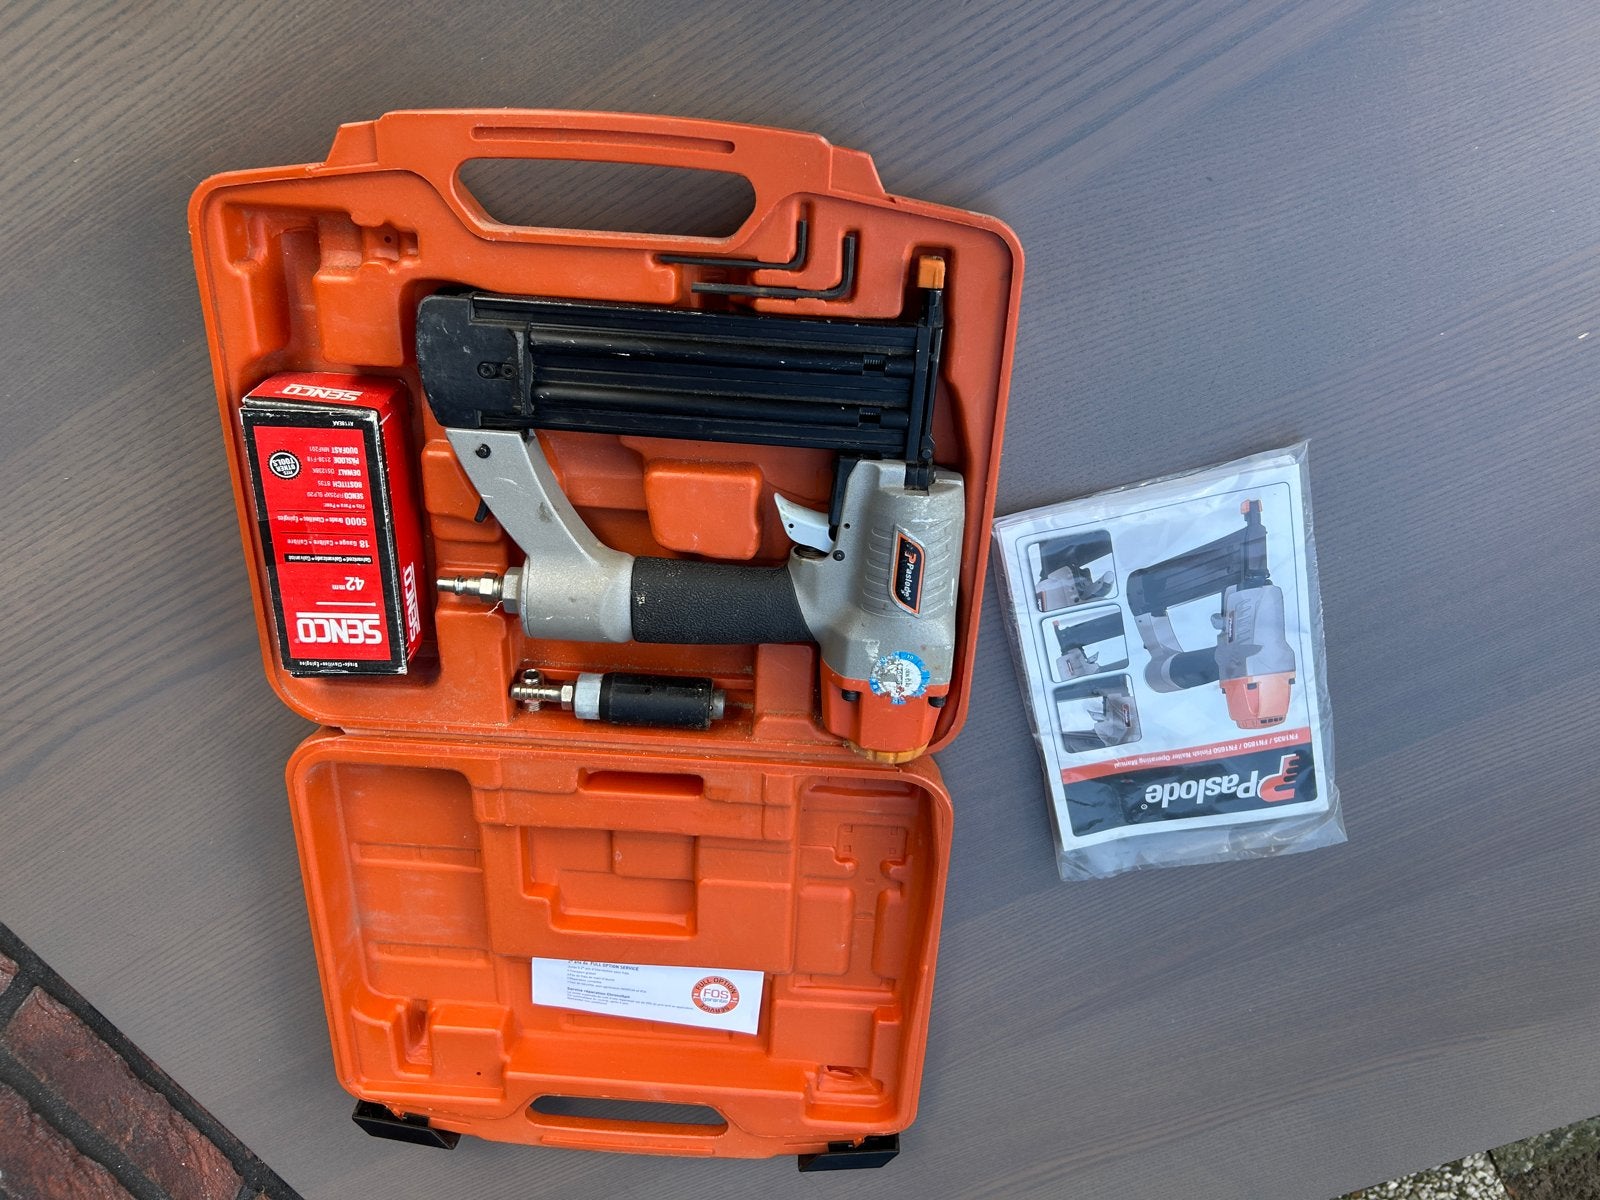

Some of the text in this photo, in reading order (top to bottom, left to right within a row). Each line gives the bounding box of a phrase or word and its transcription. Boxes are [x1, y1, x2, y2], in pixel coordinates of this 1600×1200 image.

[281, 384, 363, 401] SENCO
[272, 458, 295, 466] TOOLS
[345, 517, 367, 525] 5000
[359, 540, 369, 548] 18
[903, 564, 914, 598] Paslode
[404, 565, 421, 642] SENCO
[296, 618, 382, 644] SENCO
[1172, 752, 1191, 761] Nailer
[1192, 748, 1212, 758] Finish
[1114, 758, 1138, 768] Manual
[1138, 754, 1170, 765] Operating
[1145, 770, 1259, 808] Paslode
[696, 978, 736, 993] FULL OPTION
[704, 988, 728, 999] FOS
